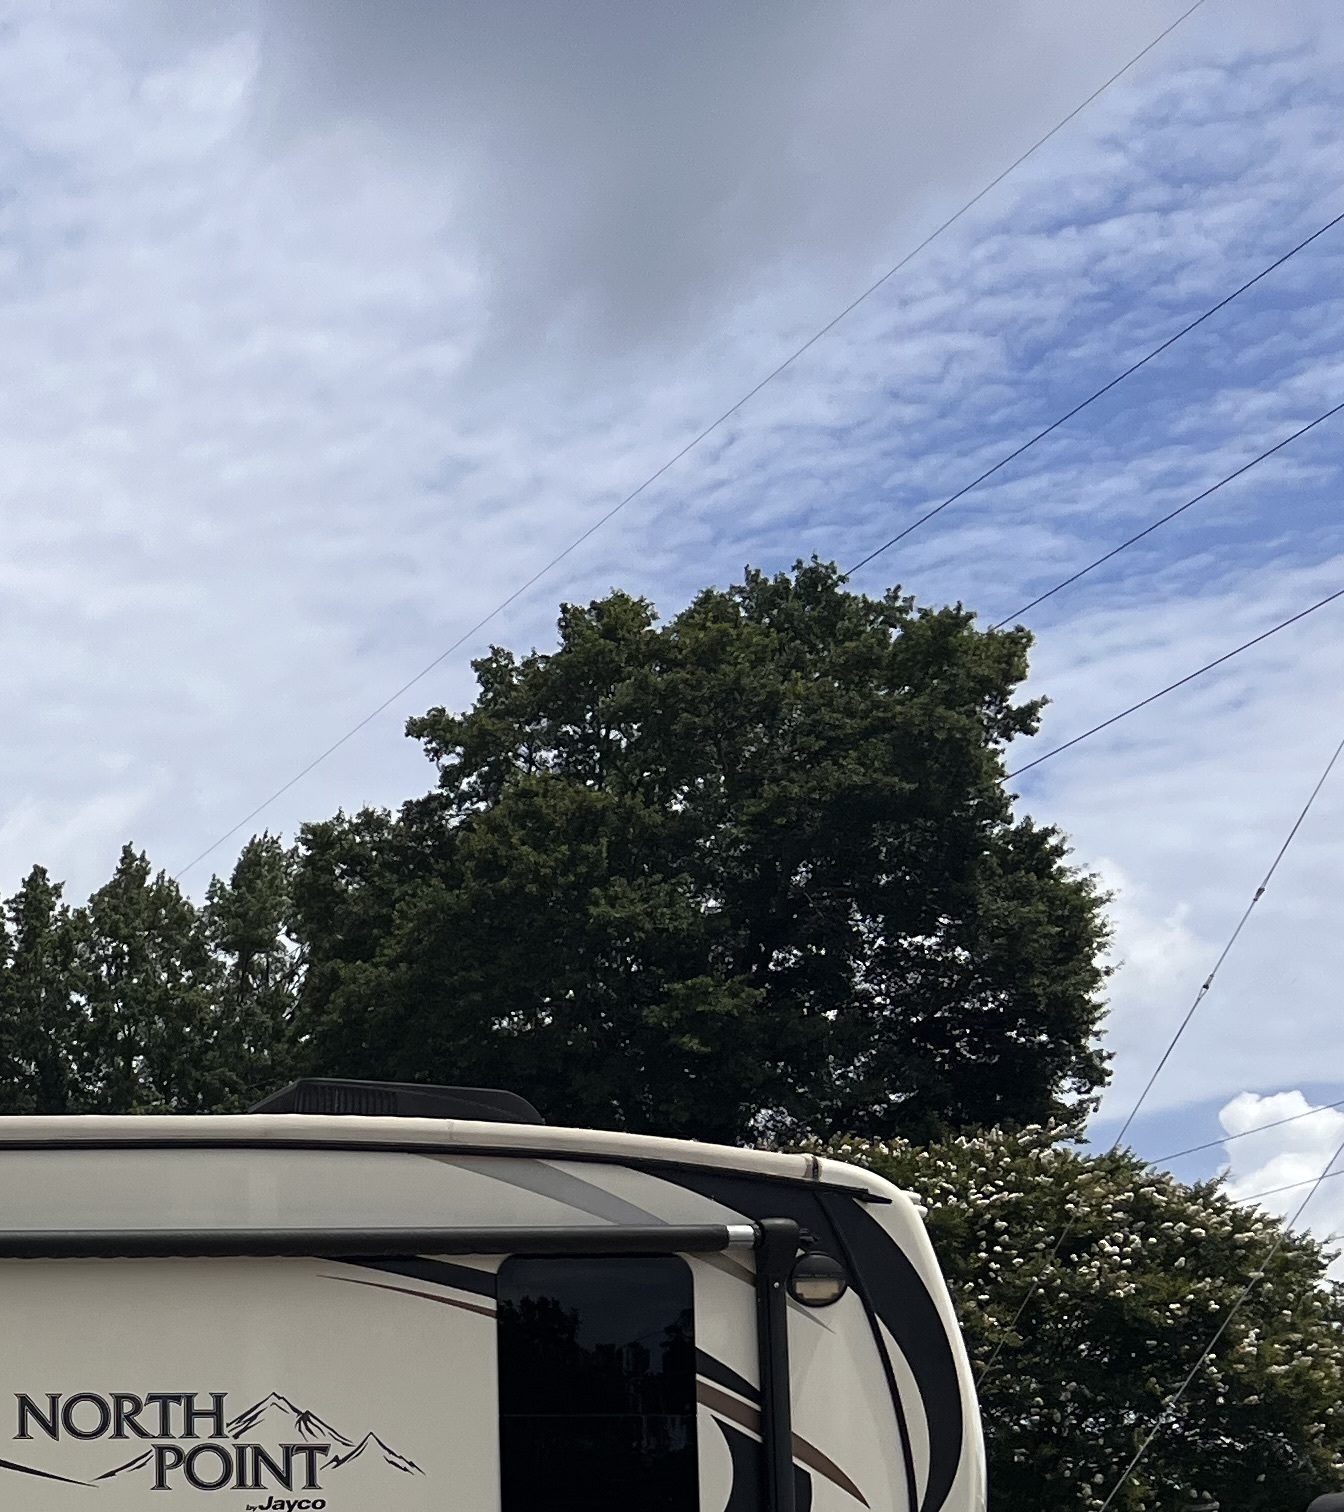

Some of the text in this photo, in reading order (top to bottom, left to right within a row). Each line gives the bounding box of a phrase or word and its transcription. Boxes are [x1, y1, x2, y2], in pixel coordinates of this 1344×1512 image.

[13, 1392, 229, 1440] NORTH
[150, 1443, 331, 1491] POINT
[245, 1496, 326, 1512] by Jayco
